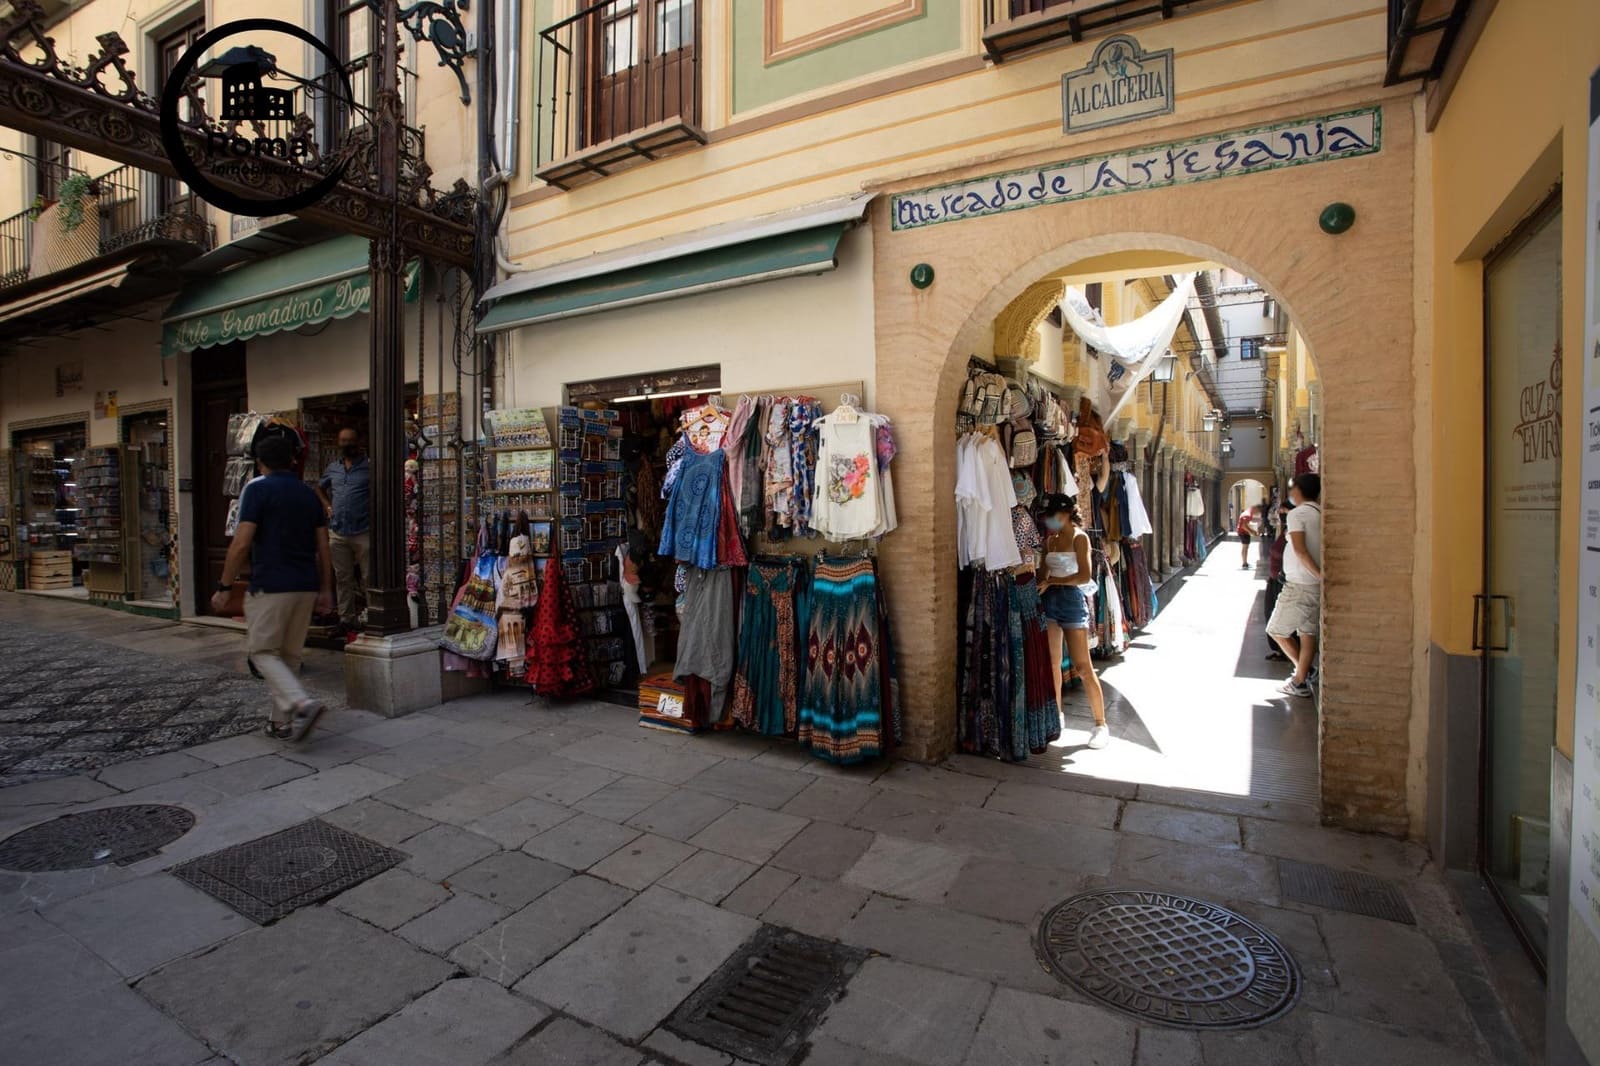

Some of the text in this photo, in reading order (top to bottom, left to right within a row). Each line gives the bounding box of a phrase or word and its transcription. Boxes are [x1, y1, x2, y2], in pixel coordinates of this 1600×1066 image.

[1070, 71, 1165, 117] ALCAICERIA
[897, 180, 1022, 225] Mercado
[1028, 171, 1073, 200] de
[173, 320, 210, 347] Arte
[220, 297, 324, 338] Granadino
